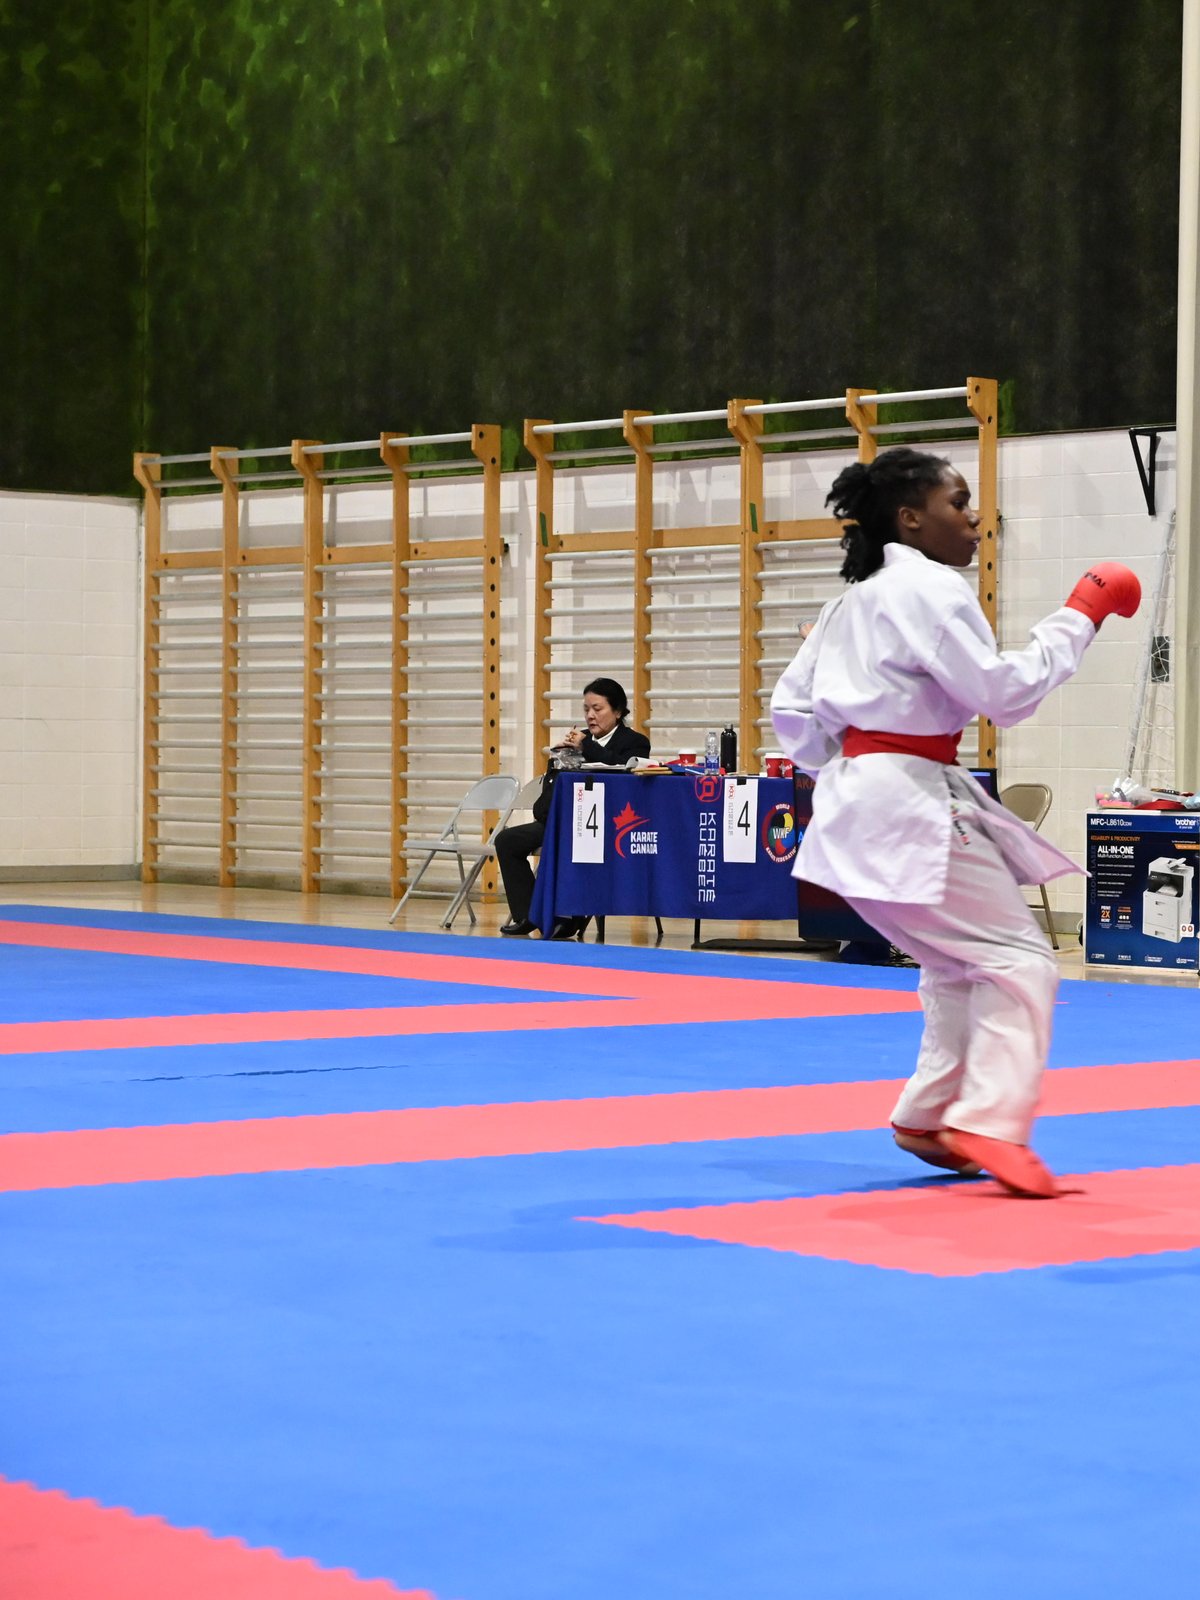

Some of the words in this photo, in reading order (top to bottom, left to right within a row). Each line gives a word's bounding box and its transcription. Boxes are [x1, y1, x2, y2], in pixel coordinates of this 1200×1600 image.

[586, 803, 598, 838] 4
[737, 800, 750, 836] 4
[1175, 818, 1197, 826] brother
[630, 832, 658, 843] KARATE
[630, 843, 658, 855] CANADA
[1098, 845, 1134, 855] ALL-IN-ONE
